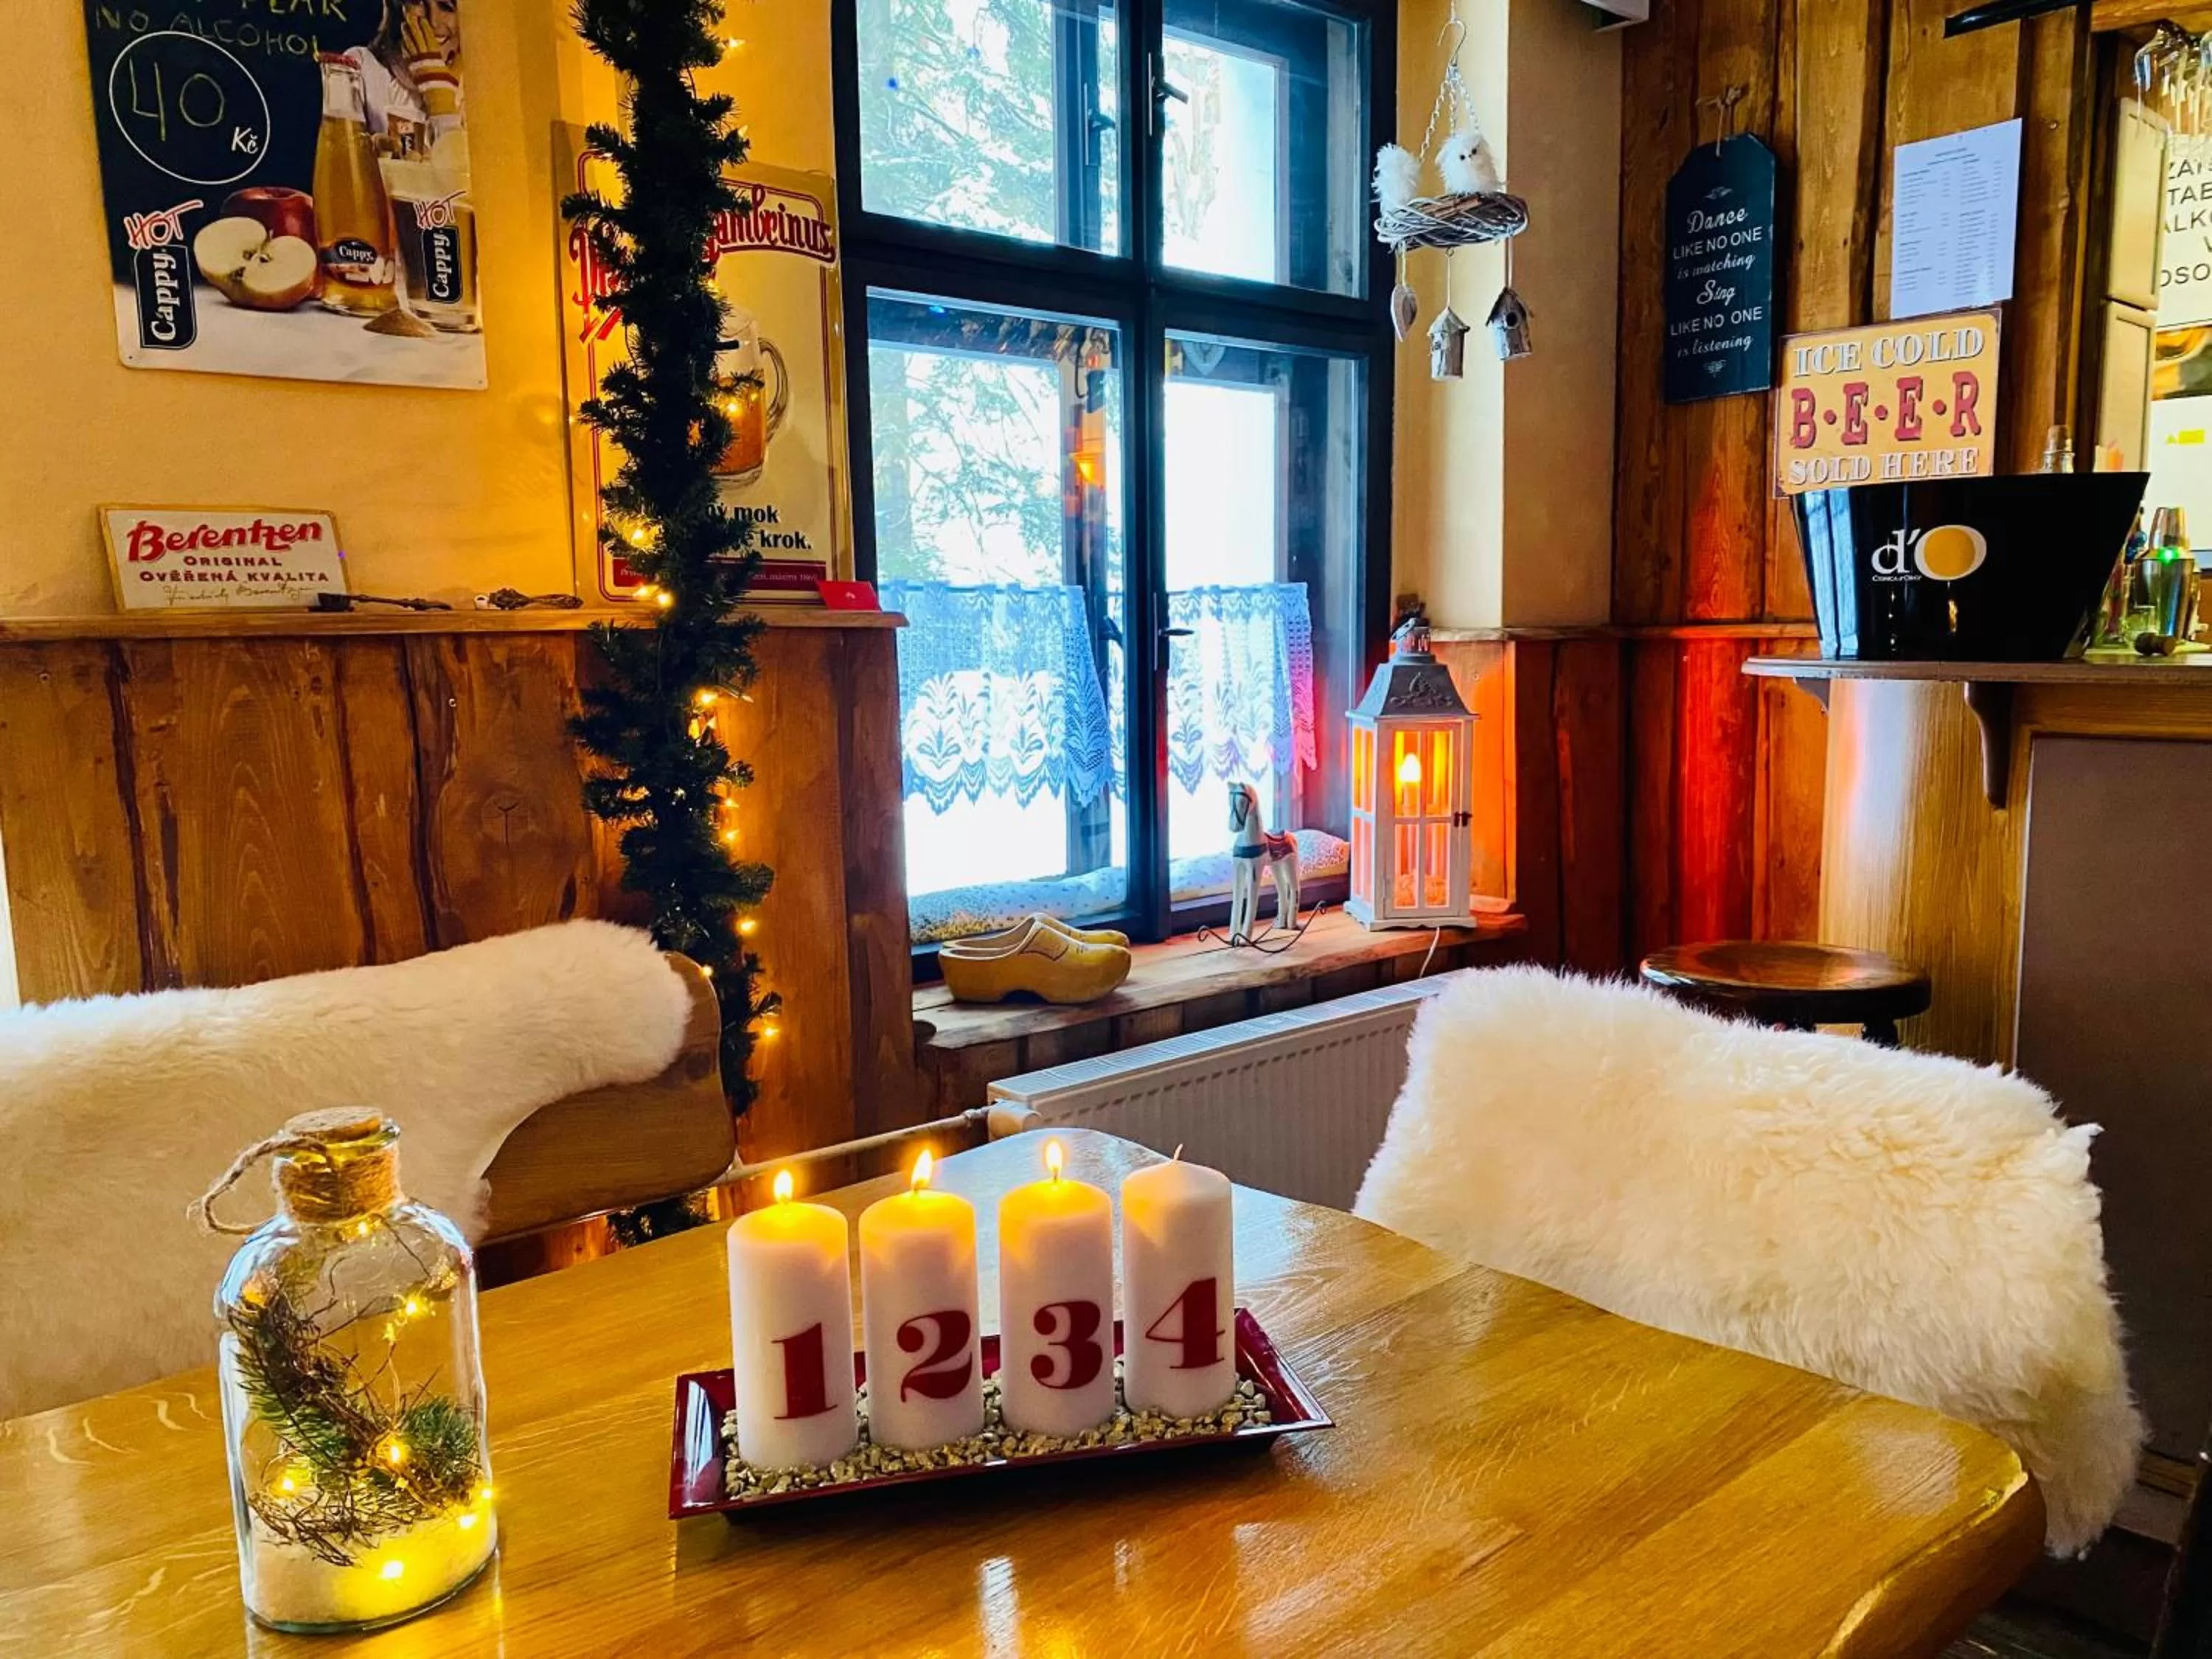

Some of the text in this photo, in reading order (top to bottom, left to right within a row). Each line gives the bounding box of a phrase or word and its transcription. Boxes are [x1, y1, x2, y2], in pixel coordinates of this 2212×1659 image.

[95, 5, 148, 32] NO
[128, 55, 258, 154] 40 Kč
[124, 200, 204, 249] HOT
[413, 189, 467, 230] HOT
[702, 184, 835, 263] ambrinus
[1687, 207, 1748, 234] Dance
[338, 245, 375, 262] Cappy
[1673, 226, 1763, 260] LIKE NO ONE
[433, 232, 452, 298] Cappy
[1677, 253, 1755, 279] is watching
[152, 252, 181, 341] Cappy
[1697, 279, 1736, 306] Sing
[1671, 306, 1763, 336] LIKE NO ONE
[1677, 335, 1753, 358] is listening
[1794, 327, 1984, 378] ICE COLD
[1790, 447, 1980, 484] SOLD HERE
[734, 505, 779, 524] mok
[127, 518, 321, 563] Berentzen
[760, 529, 812, 549] krok.
[140, 569, 329, 582] OVĚŘENÁ KVALITA
[184, 555, 282, 567] ORIGINAL
[1145, 1276, 1225, 1369] 4
[897, 1310, 973, 1403] 2
[1030, 1300, 1103, 1390] 3
[771, 1322, 839, 1420] 1
